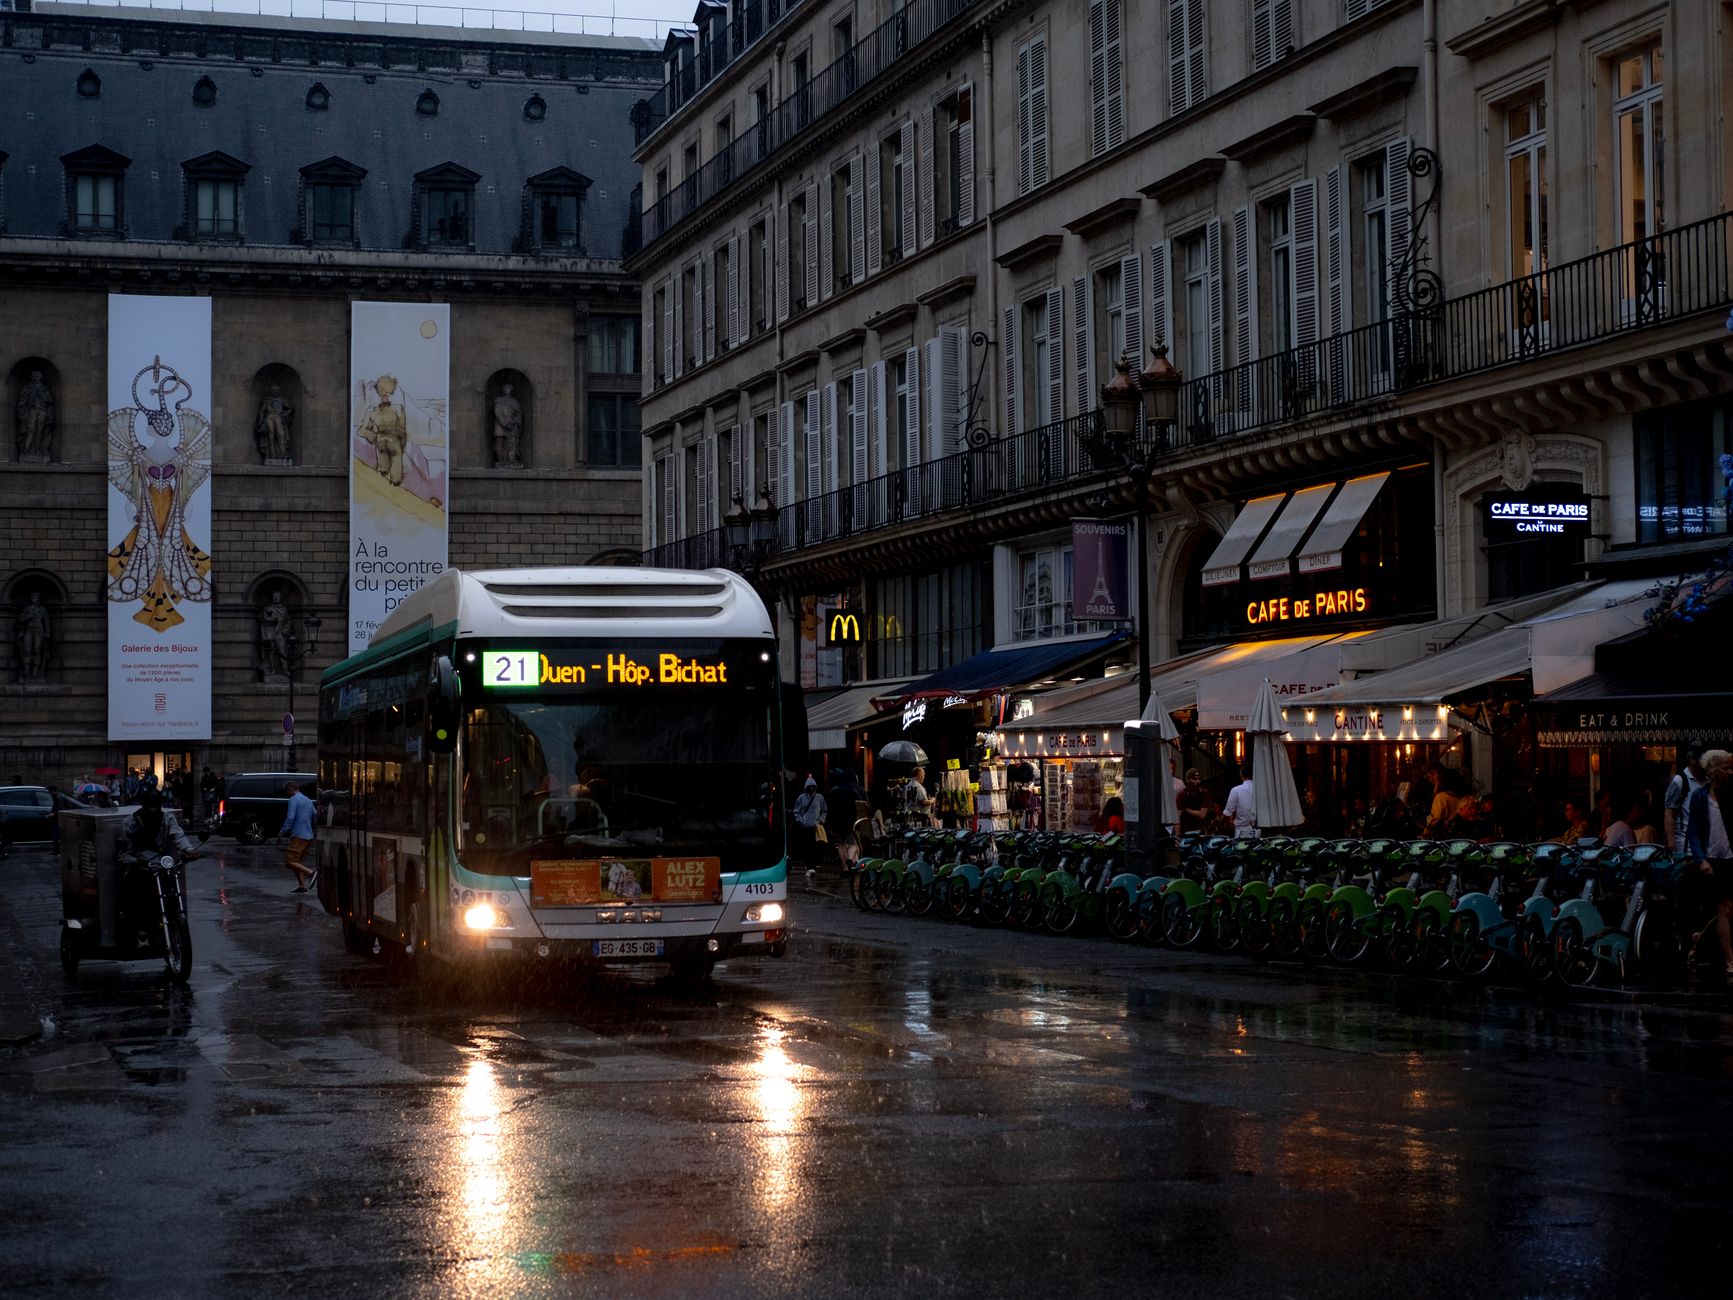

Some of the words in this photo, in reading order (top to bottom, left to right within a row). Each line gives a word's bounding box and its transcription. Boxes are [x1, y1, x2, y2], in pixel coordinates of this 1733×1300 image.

[1491, 503, 1530, 516] CAFE
[1531, 505, 1545, 514] DE
[1548, 504, 1588, 517] PARIS
[1074, 524, 1126, 536] SOUVENIRS
[1516, 522, 1564, 533] CANTINE
[355, 537, 369, 558] À
[374, 541, 388, 558] la
[355, 559, 443, 574] rencontre
[1253, 562, 1286, 575] COMPTOIR
[355, 575, 379, 592] du
[1086, 604, 1116, 615] PARIS
[1247, 597, 1290, 624] CAFE
[1294, 599, 1311, 619] DE
[1315, 587, 1367, 616] PARIS
[355, 621, 363, 629] 17
[355, 631, 366, 639] 26
[121, 644, 152, 653] Galerie
[153, 644, 169, 653] des
[171, 644, 199, 654] Bijoux
[495, 655, 526, 682] 21
[607, 653, 654, 686] Hôp.
[659, 653, 727, 683] Bichat
[1334, 714, 1384, 730] CANTINE
[1579, 713, 1605, 728] EAT
[1610, 714, 1618, 727] &
[1625, 711, 1669, 727] DRINK
[666, 861, 706, 874] ALEX
[667, 874, 706, 887] LUTZ
[745, 883, 774, 895] 4103
